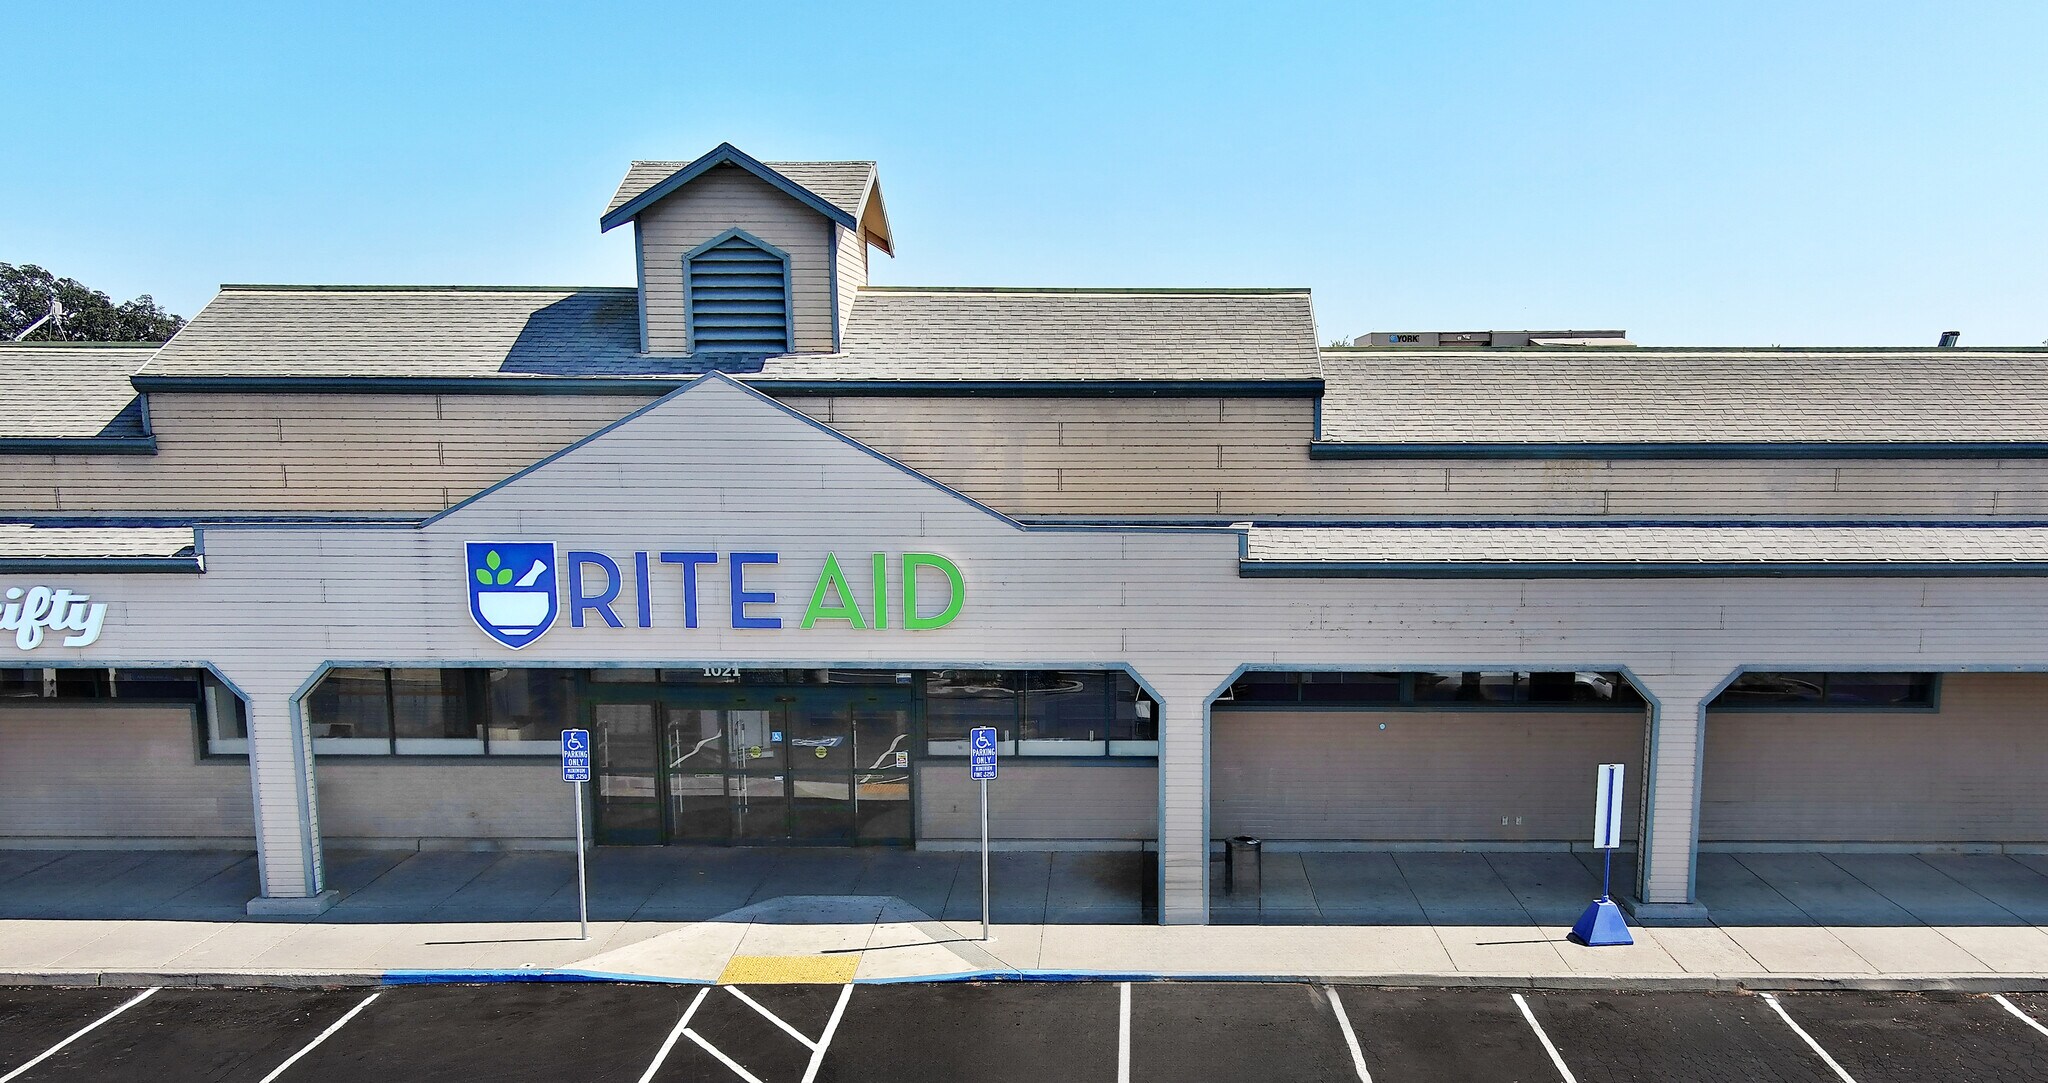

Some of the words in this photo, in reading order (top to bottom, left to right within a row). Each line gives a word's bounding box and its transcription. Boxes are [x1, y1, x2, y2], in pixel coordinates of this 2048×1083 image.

[1397, 335, 1419, 343] YORK
[566, 550, 783, 629] RITE
[799, 551, 966, 630] AID
[0, 585, 108, 651] ifty
[703, 667, 741, 677] 1021
[564, 750, 588, 759] PARKING
[972, 748, 996, 757] PARKING
[568, 758, 584, 766] ONLY
[976, 756, 992, 765] ONLY
